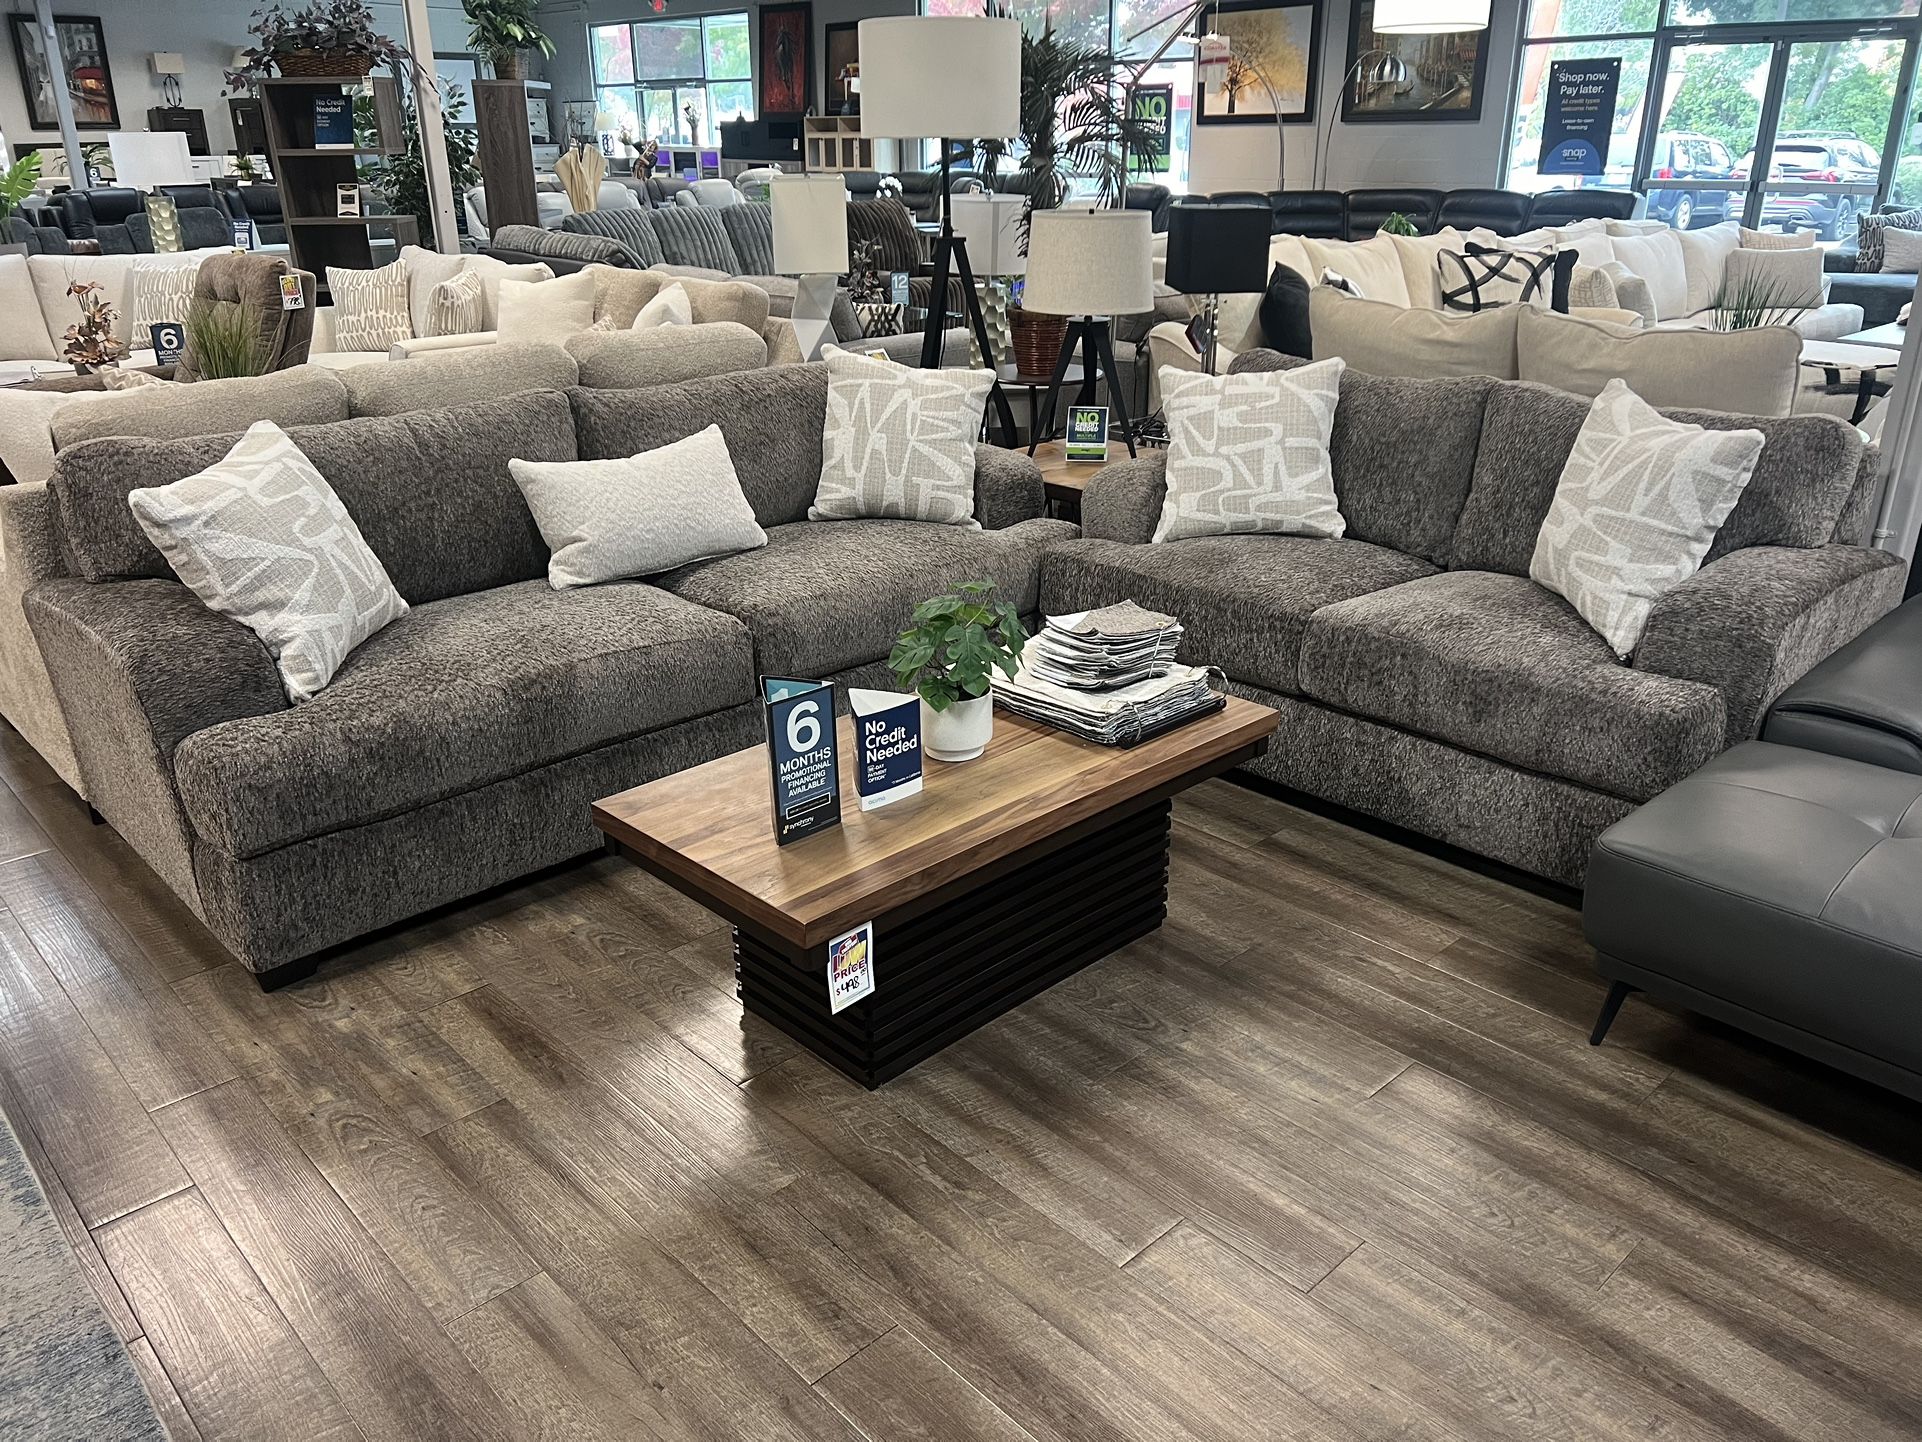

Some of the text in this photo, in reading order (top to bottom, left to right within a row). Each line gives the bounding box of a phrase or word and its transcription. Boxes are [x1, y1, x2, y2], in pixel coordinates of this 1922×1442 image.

[1558, 72, 1610, 84] Shop now.
[1560, 84, 1605, 96] Pay later.
[316, 105, 342, 113] Needed
[1561, 148, 1587, 159] snap
[90, 167, 98, 178] 6
[892, 275, 909, 289] 12
[160, 328, 179, 350] 6
[1075, 411, 1100, 423] NO
[786, 700, 821, 753] 6
[865, 720, 886, 736] No
[865, 727, 907, 750] Credit
[866, 734, 918, 764] Needed
[780, 746, 832, 775] MONTHS
[781, 760, 832, 783] PROMOTIONAL
[788, 769, 826, 789] FINANCING
[788, 777, 827, 798] AVAILABLE
[789, 816, 815, 830] synchrony
[833, 959, 866, 982] PRICE
